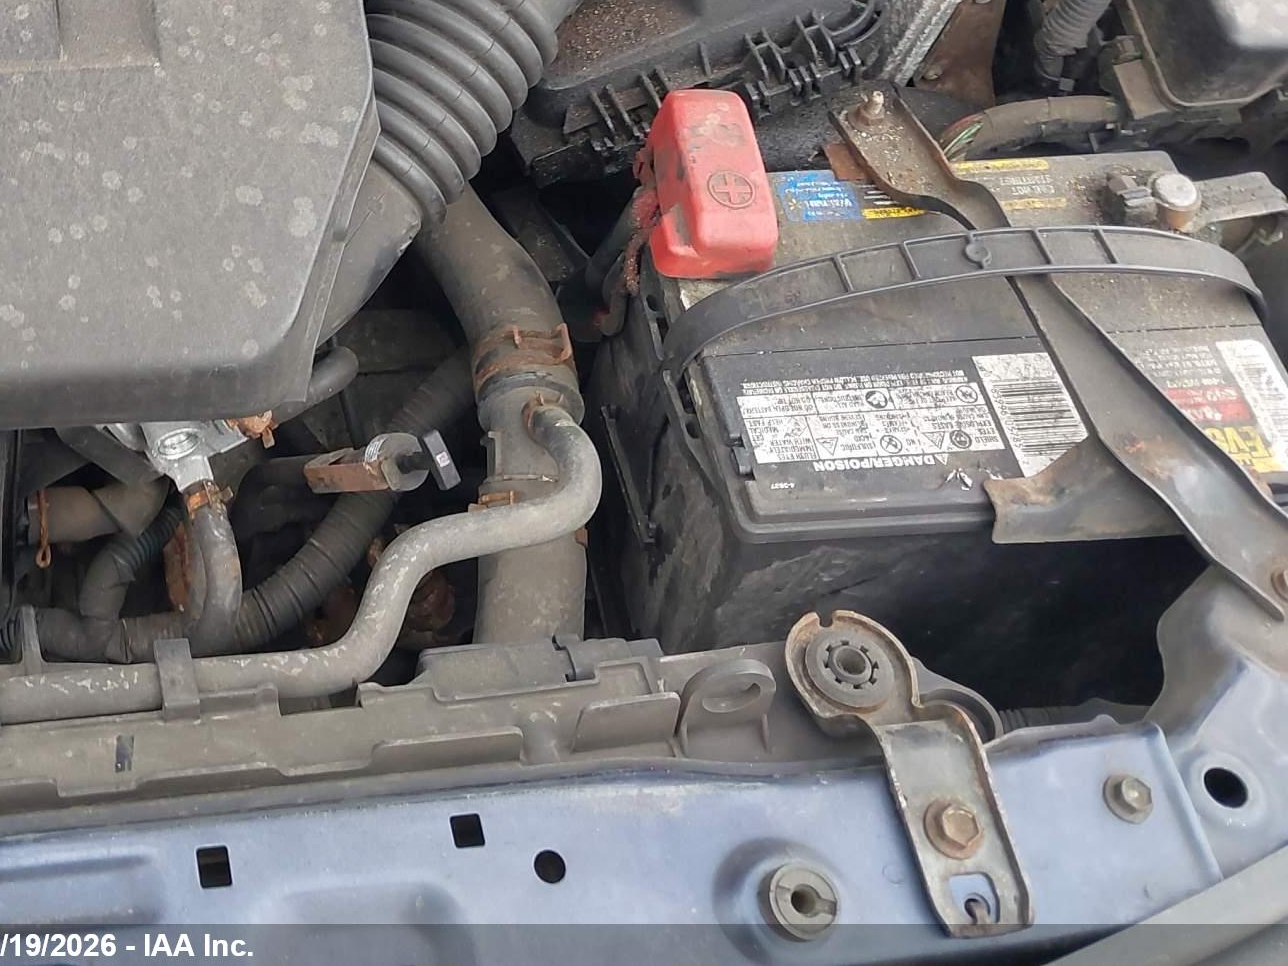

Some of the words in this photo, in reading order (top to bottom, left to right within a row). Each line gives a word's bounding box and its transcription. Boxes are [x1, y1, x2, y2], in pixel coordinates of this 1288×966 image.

[977, 427, 995, 436] EYES
[974, 435, 999, 444] SHIELD
[813, 454, 936, 472] DANGER/POISON
